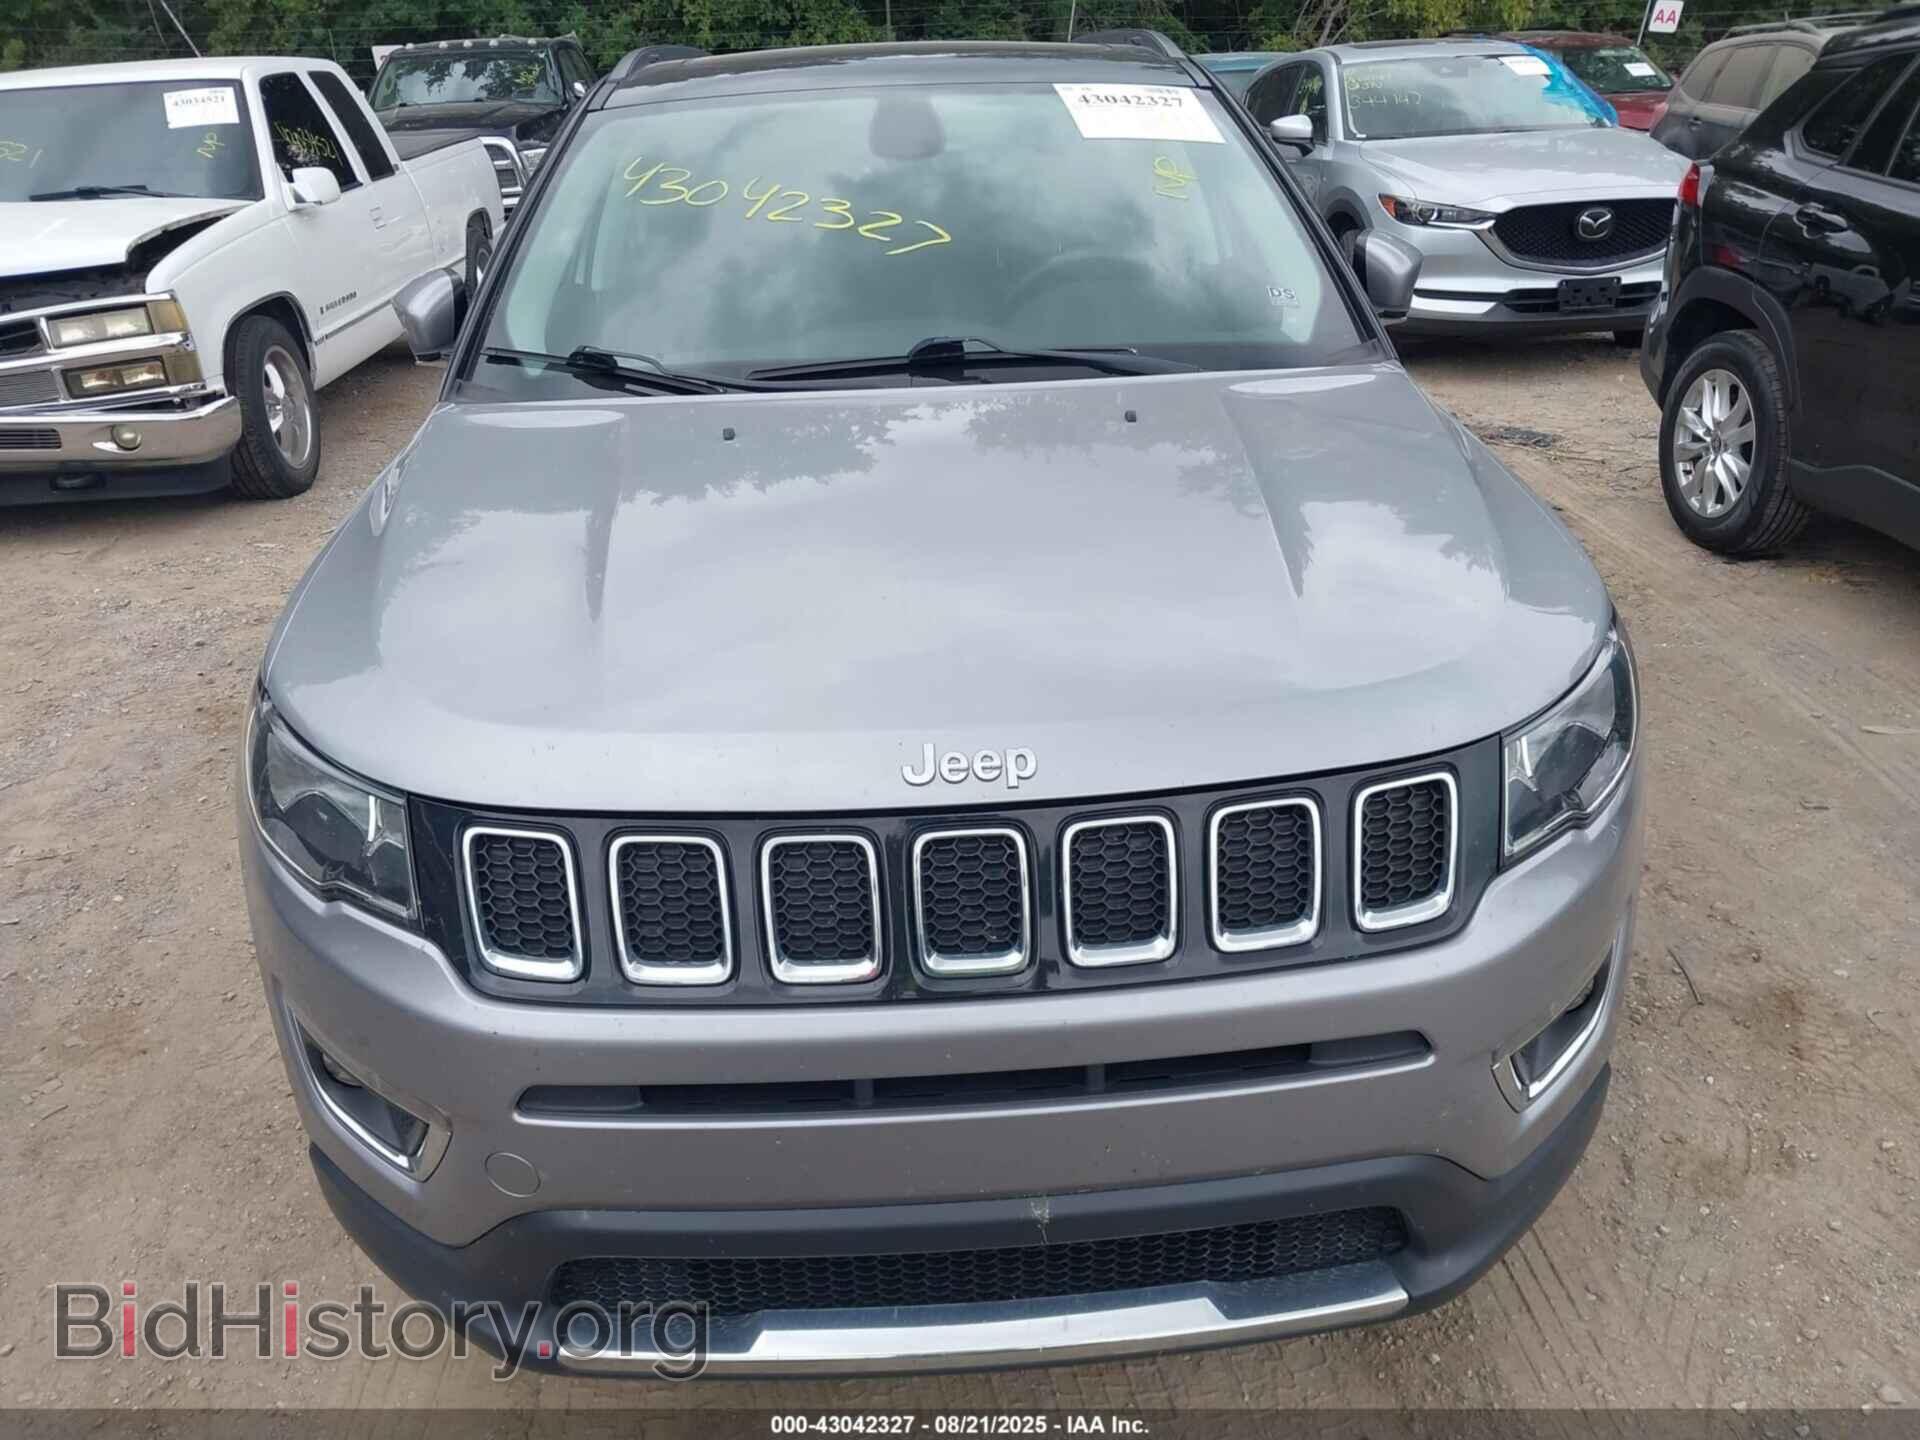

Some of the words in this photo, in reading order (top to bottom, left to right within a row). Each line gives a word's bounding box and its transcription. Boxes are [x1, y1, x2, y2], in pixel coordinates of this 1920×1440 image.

[1653, 9, 1677, 25] AA
[1077, 94, 1183, 108] 43042327
[902, 743, 1037, 789] Jeep
